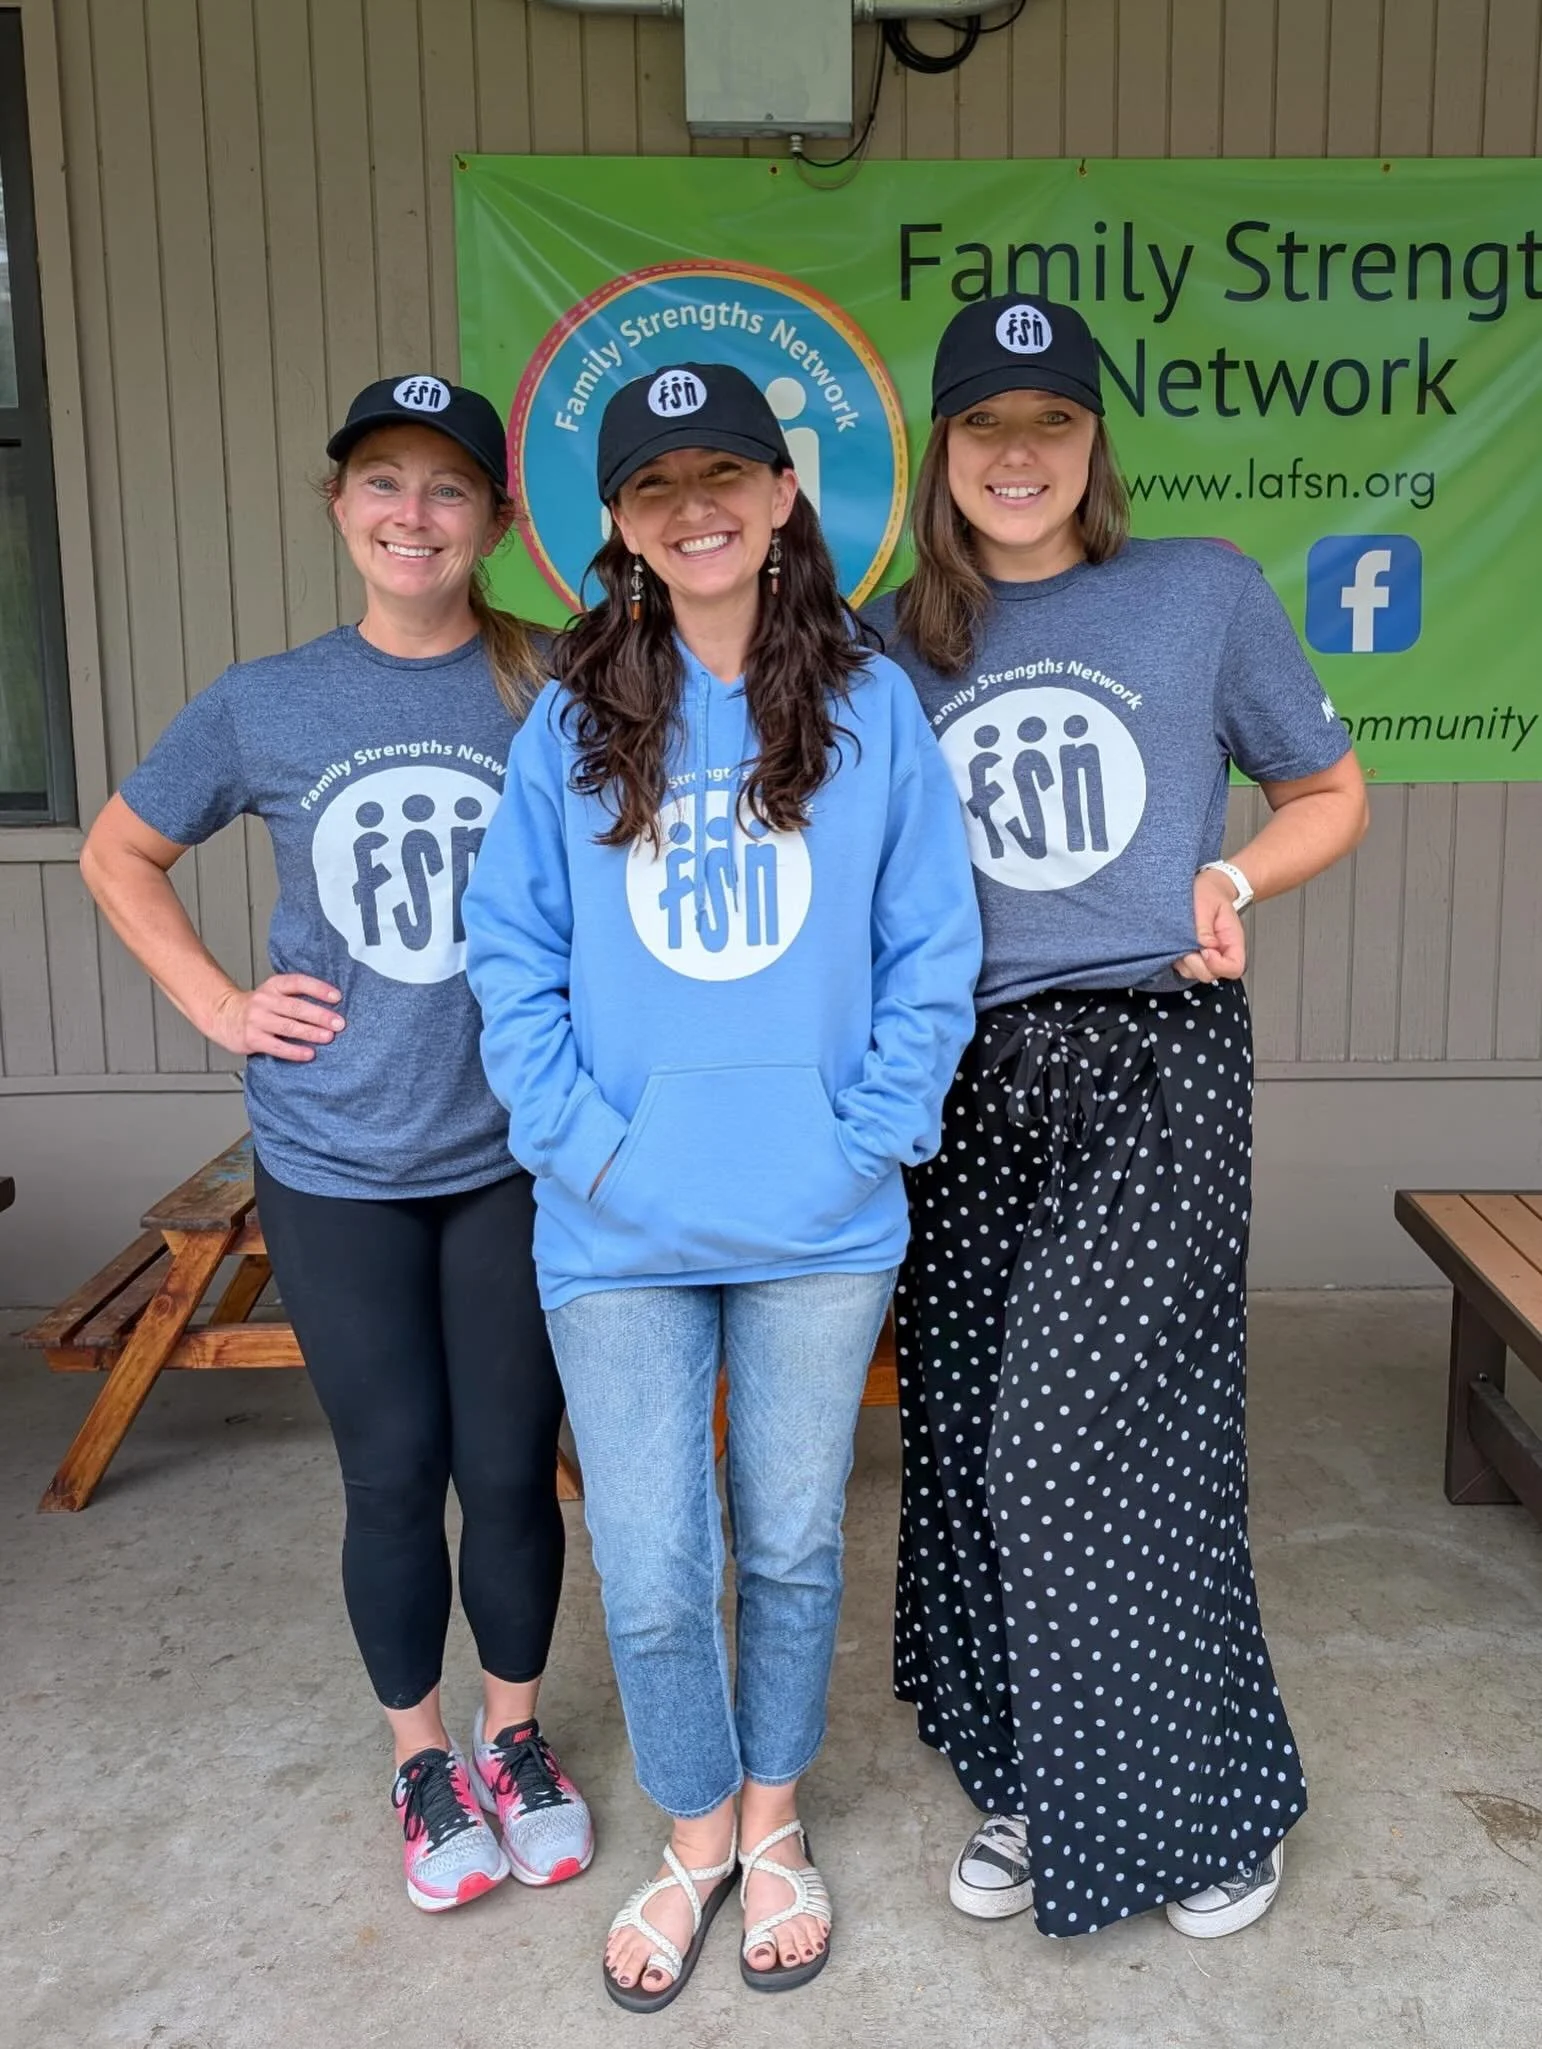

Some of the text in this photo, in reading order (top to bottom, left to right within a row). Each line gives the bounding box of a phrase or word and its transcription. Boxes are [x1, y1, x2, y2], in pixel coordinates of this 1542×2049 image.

[899, 220, 1542, 323] Family Strengt
[555, 302, 858, 432] Family Strengths Network
[1093, 337, 1458, 418] Network
[1124, 457, 1435, 510] www.lafsn.org
[928, 657, 1143, 727] amily Strengths Network
[1339, 705, 1539, 752] mmunity
[300, 740, 508, 811] Family Strengths Netw
